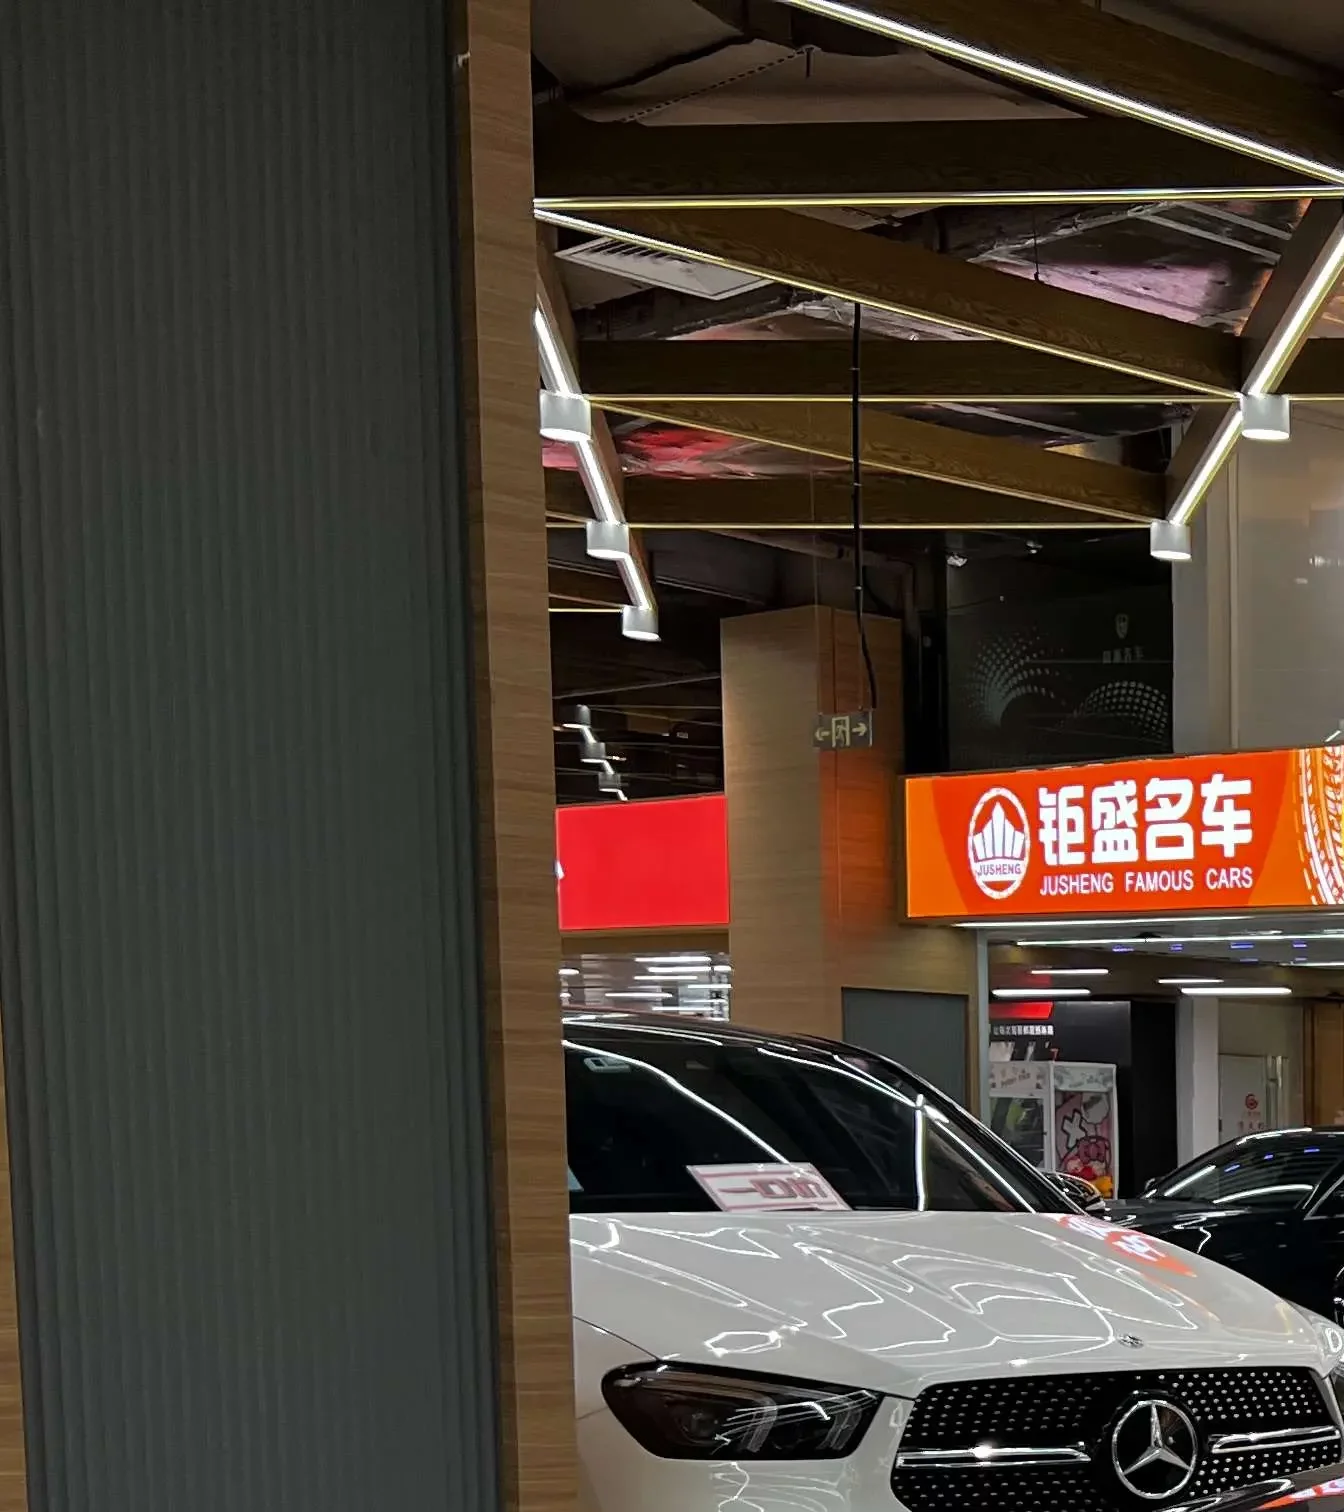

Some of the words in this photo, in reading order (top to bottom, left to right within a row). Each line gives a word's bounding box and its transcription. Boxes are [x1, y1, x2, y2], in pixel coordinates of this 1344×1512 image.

[1038, 773, 1253, 868] 钜盛名车
[976, 861, 1022, 877] JUSHENG
[1040, 872, 1114, 896] JUSHENG
[1125, 869, 1194, 892] FAMOUS
[1206, 866, 1253, 890] CARS
